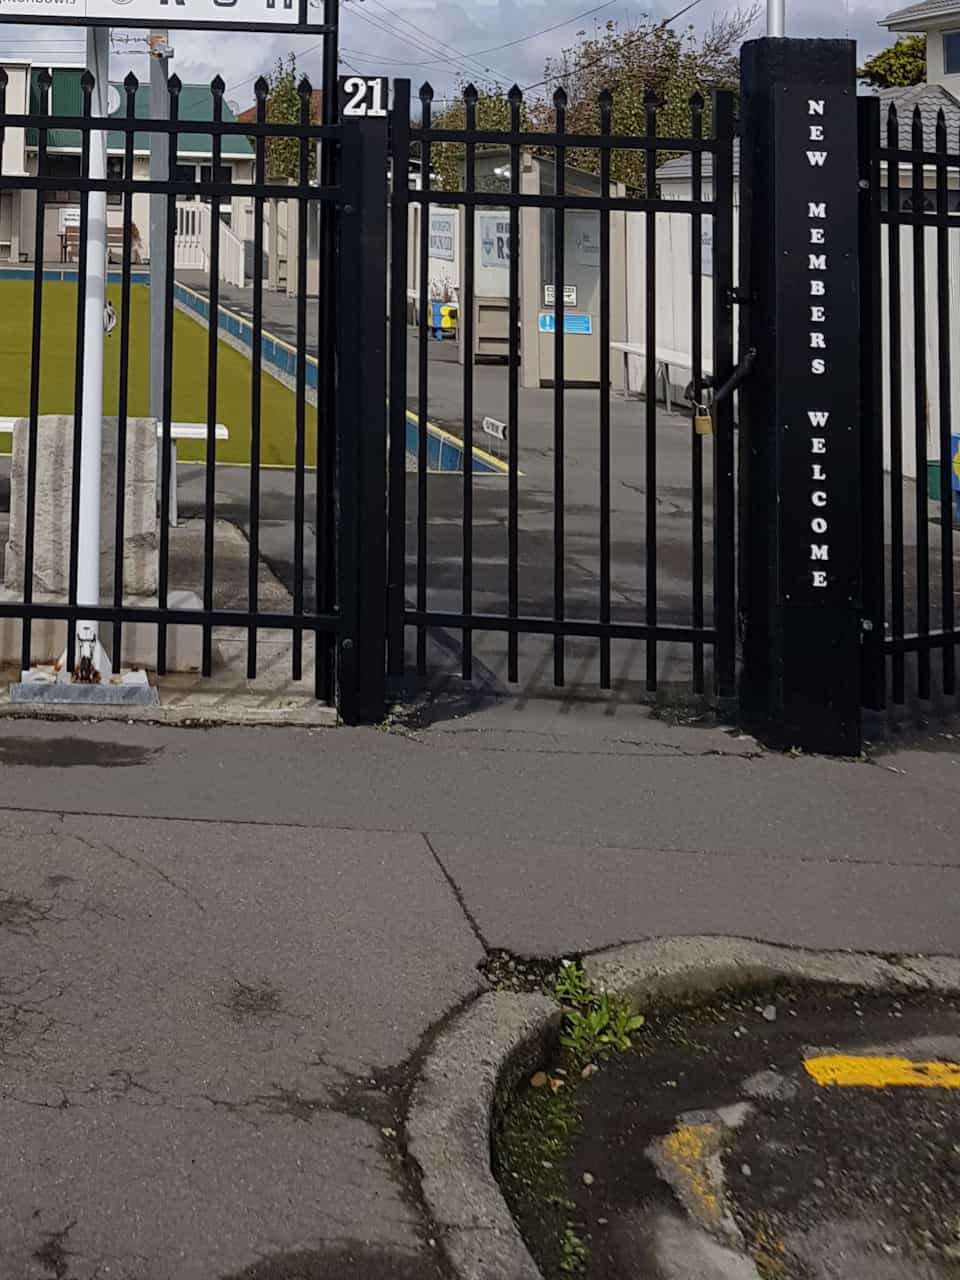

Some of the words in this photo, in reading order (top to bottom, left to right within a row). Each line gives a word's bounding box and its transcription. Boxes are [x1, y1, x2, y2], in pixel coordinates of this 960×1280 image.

[342, 77, 387, 117] 21
[805, 99, 828, 167] NEW
[807, 202, 827, 374] MEMBERS
[807, 411, 830, 587] WELCOME
